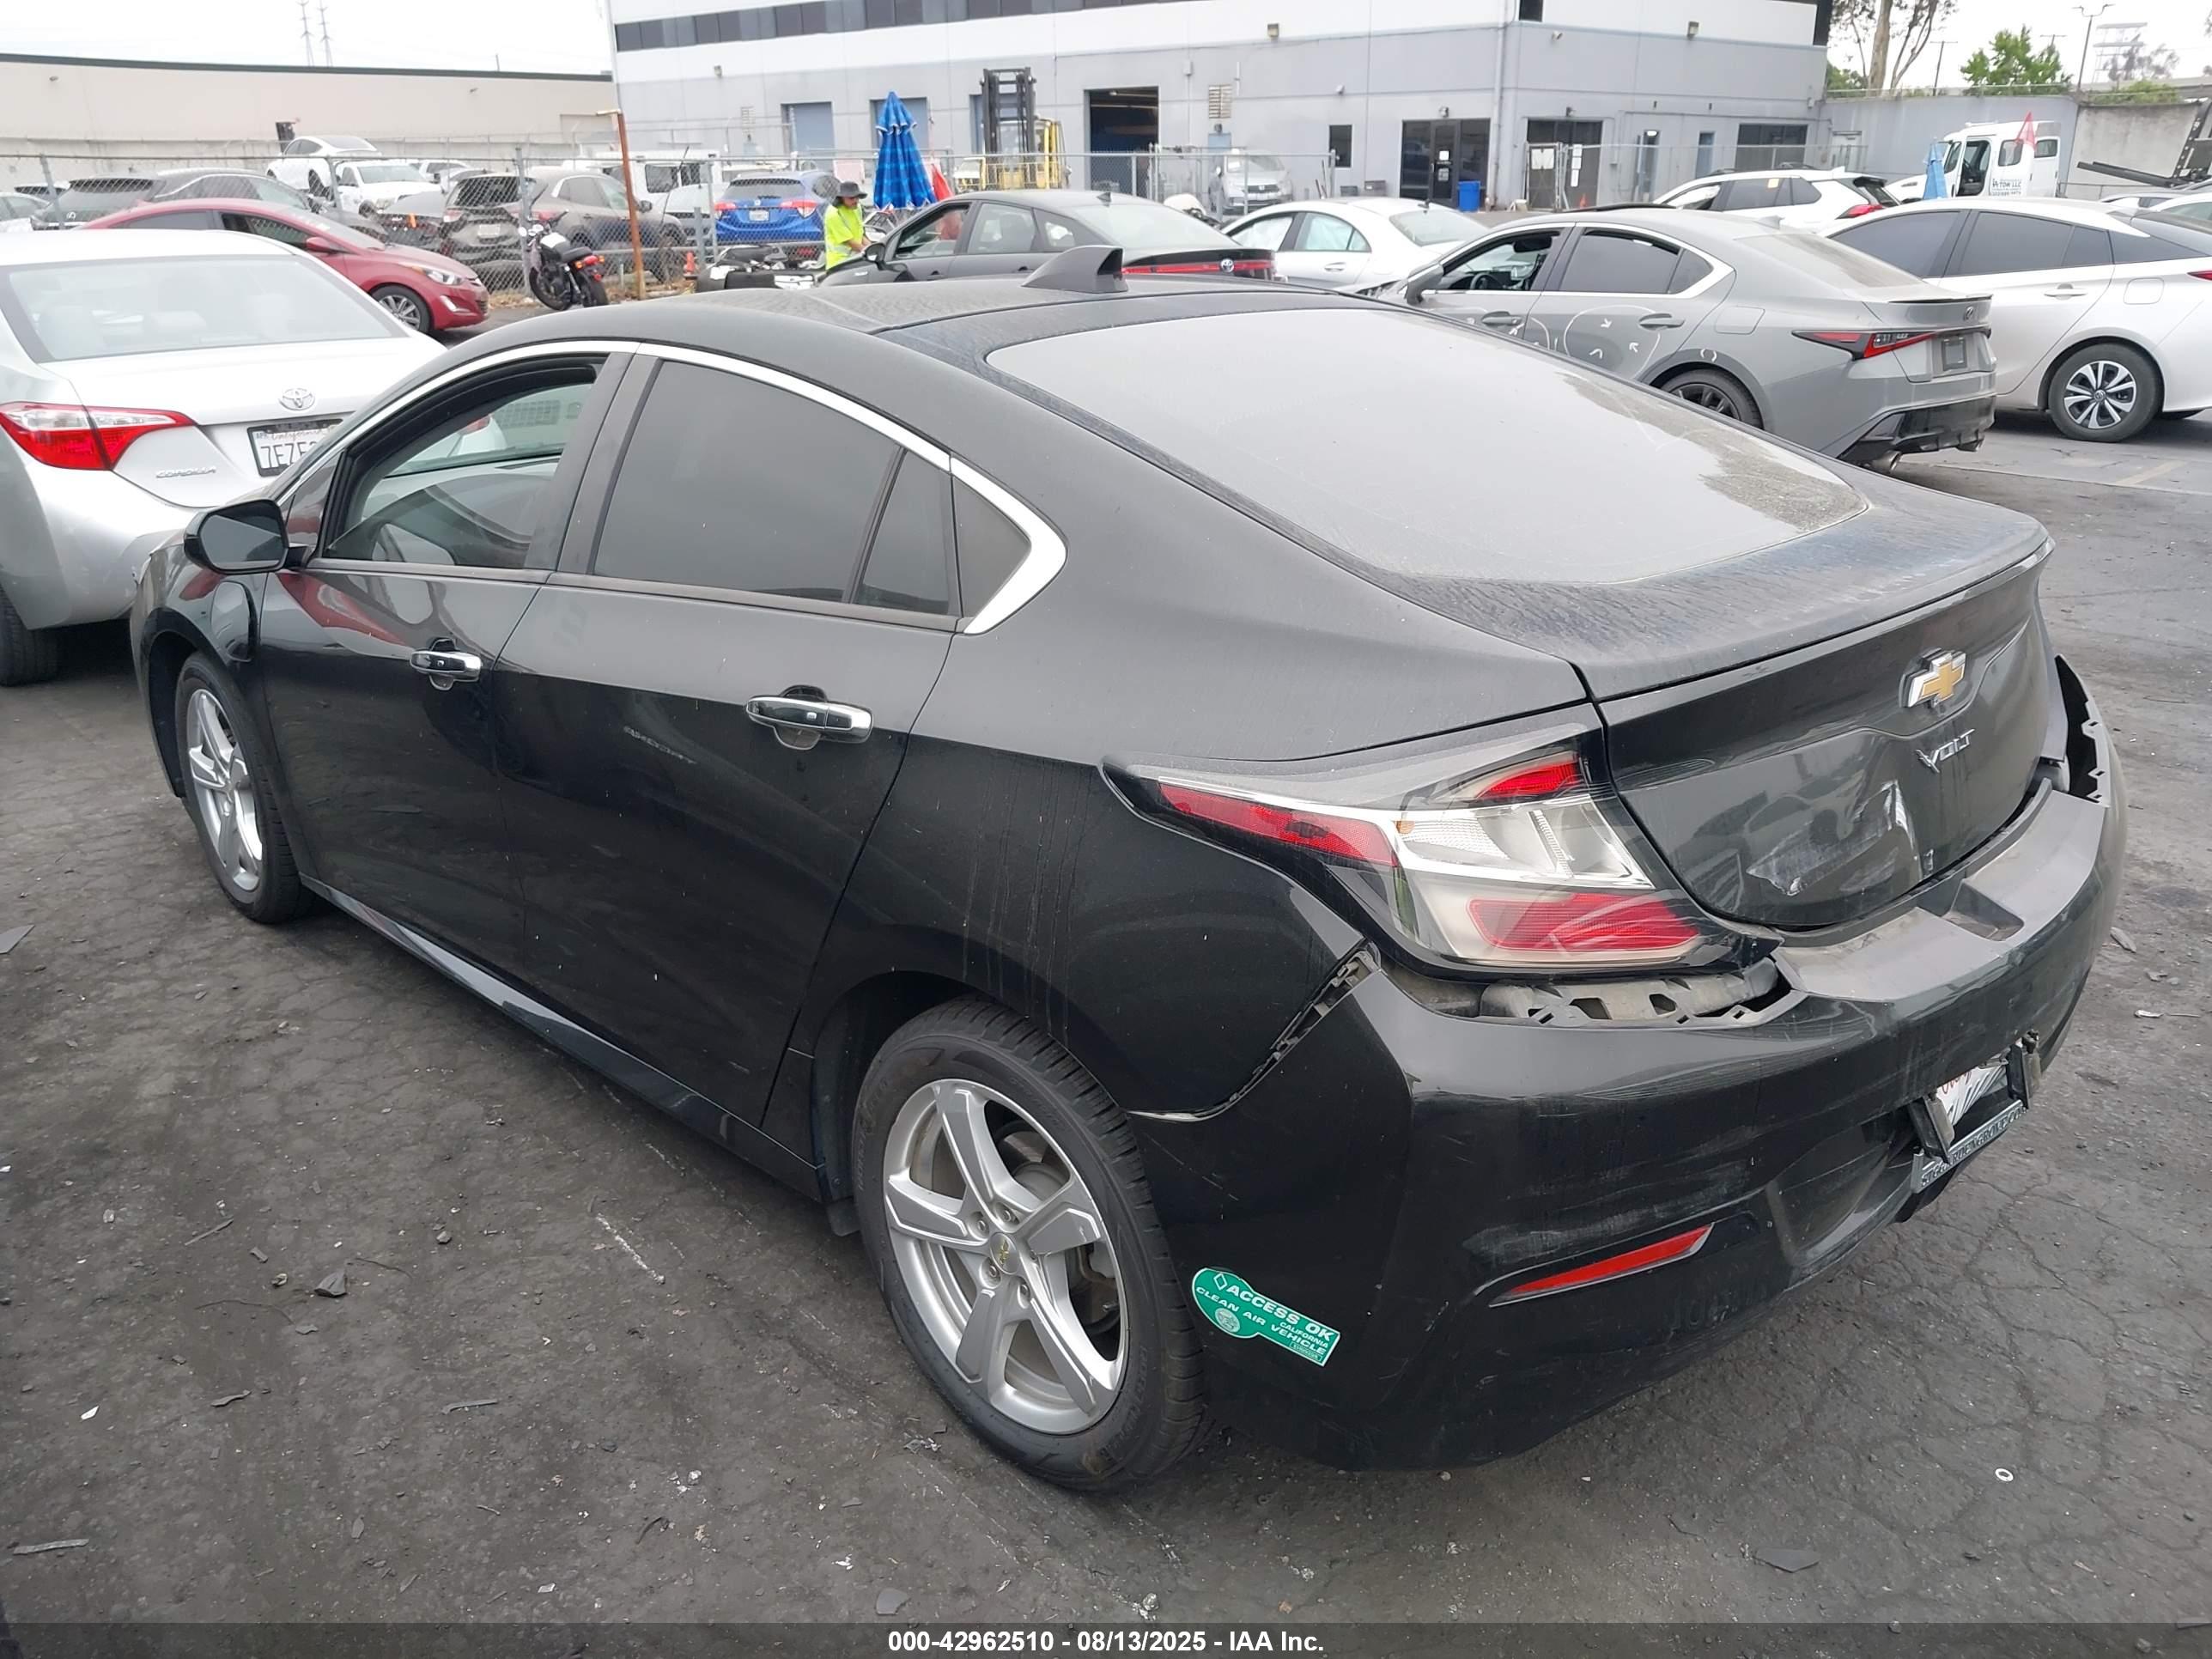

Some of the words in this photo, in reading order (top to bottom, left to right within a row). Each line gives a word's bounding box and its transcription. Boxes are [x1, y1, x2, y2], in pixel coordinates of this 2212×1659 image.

[155, 465, 217, 478] COROLLA
[1916, 728, 1975, 773] VOLT
[1195, 1286, 1240, 1312] CLEAN
[1243, 1310, 1267, 1326] AIR
[1271, 1323, 1327, 1356] VEHICLE
[1226, 1285, 1300, 1325] ACCESS
[1304, 1322, 1335, 1342] OK
[1279, 1321, 1329, 1349] CALIFORNIA
